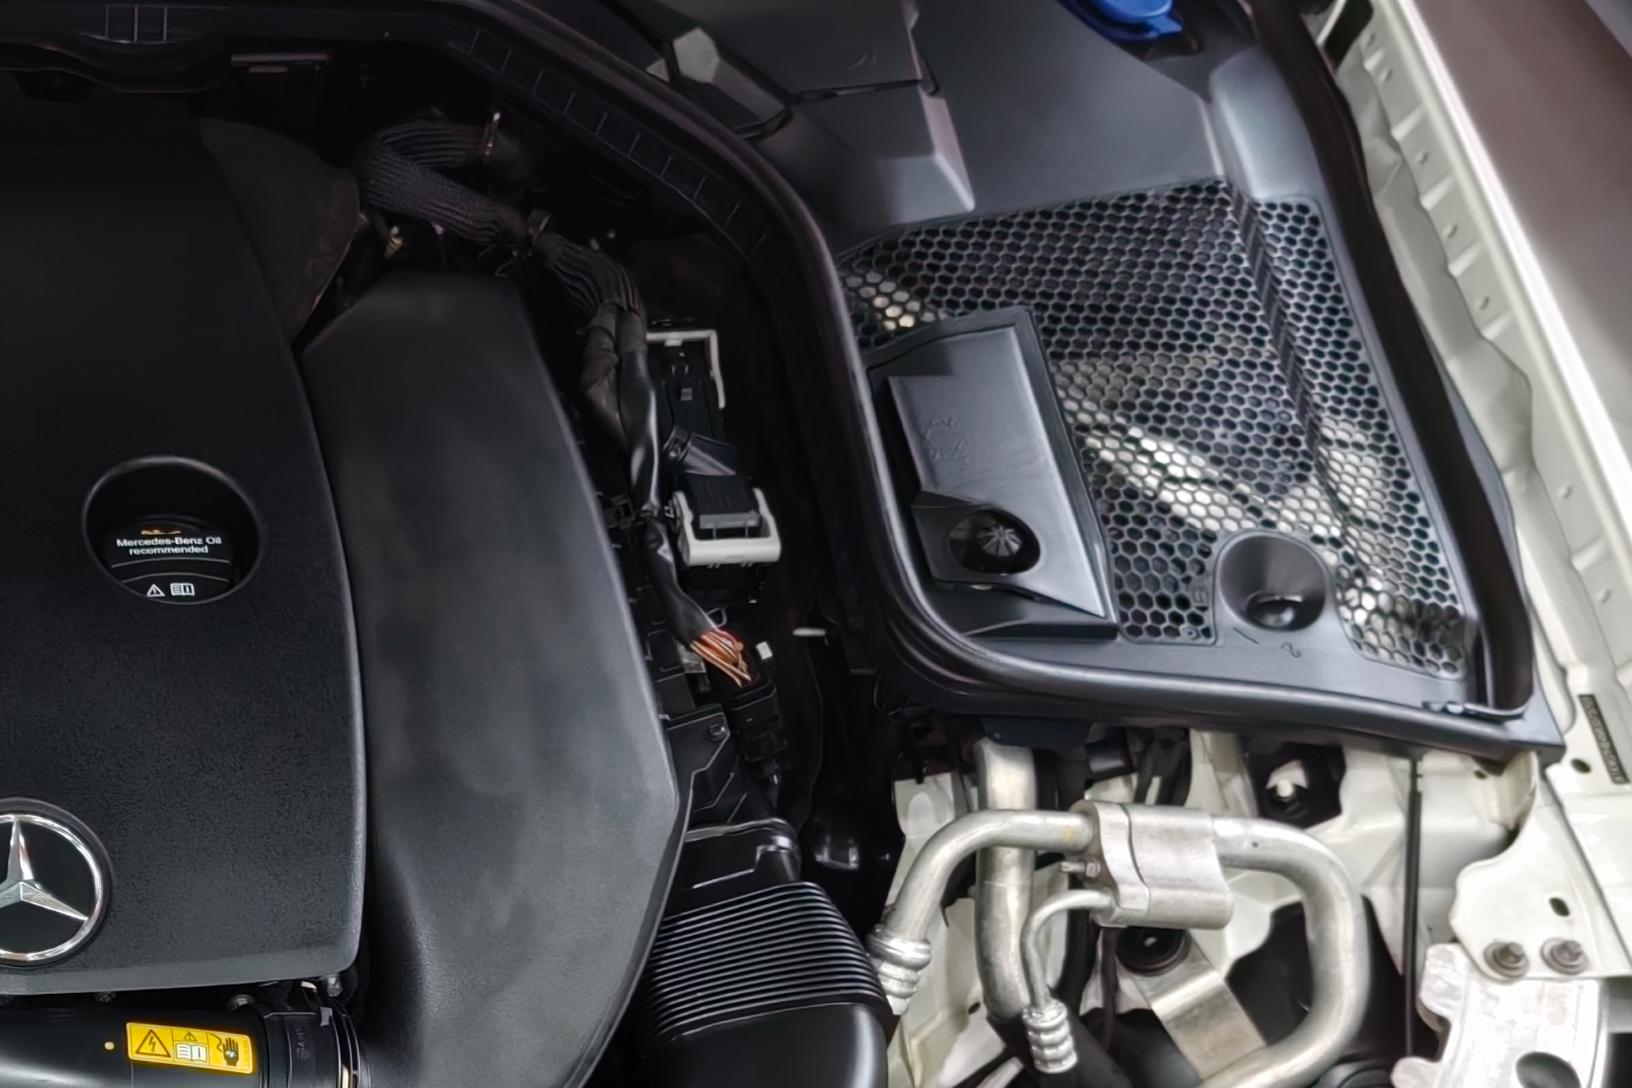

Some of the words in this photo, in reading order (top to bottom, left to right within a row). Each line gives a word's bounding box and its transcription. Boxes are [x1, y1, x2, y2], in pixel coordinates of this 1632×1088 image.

[116, 537, 203, 546] Mercedes-Benz
[205, 536, 222, 544] Oil
[129, 545, 209, 555] recommended
